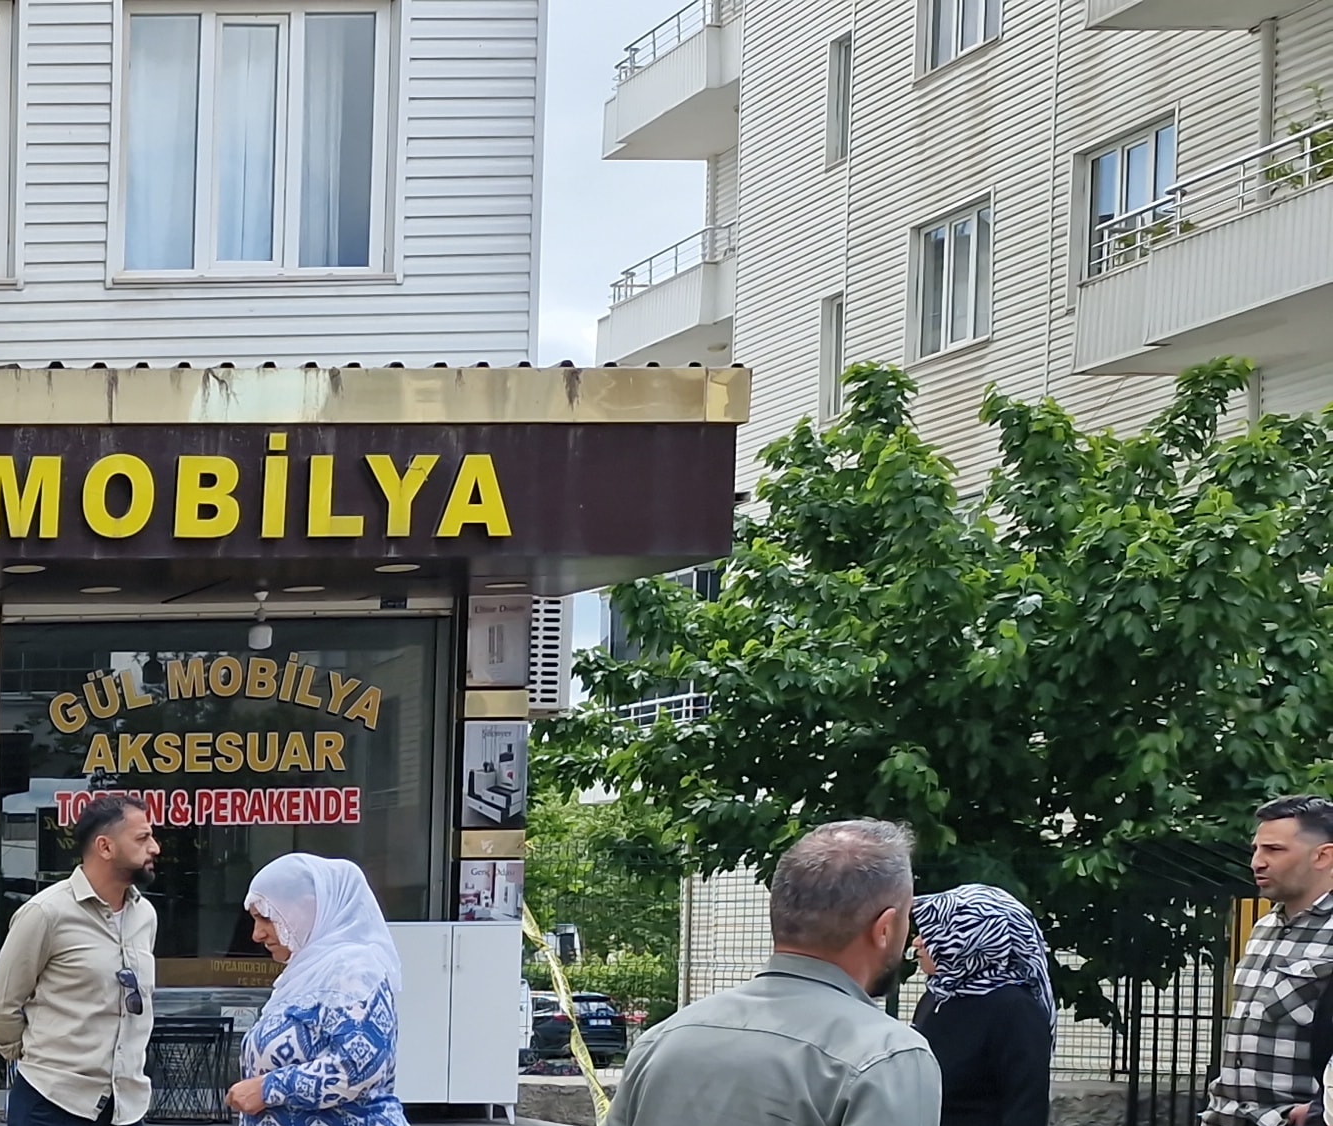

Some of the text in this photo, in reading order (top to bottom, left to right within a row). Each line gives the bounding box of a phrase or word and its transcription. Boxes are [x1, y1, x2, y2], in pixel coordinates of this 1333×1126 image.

[48, 651, 383, 736] GÜL MOBİLYA
[81, 729, 346, 776] AKSESUAR
[168, 789, 192, 826] &
[195, 787, 361, 825] PERAKENDE
